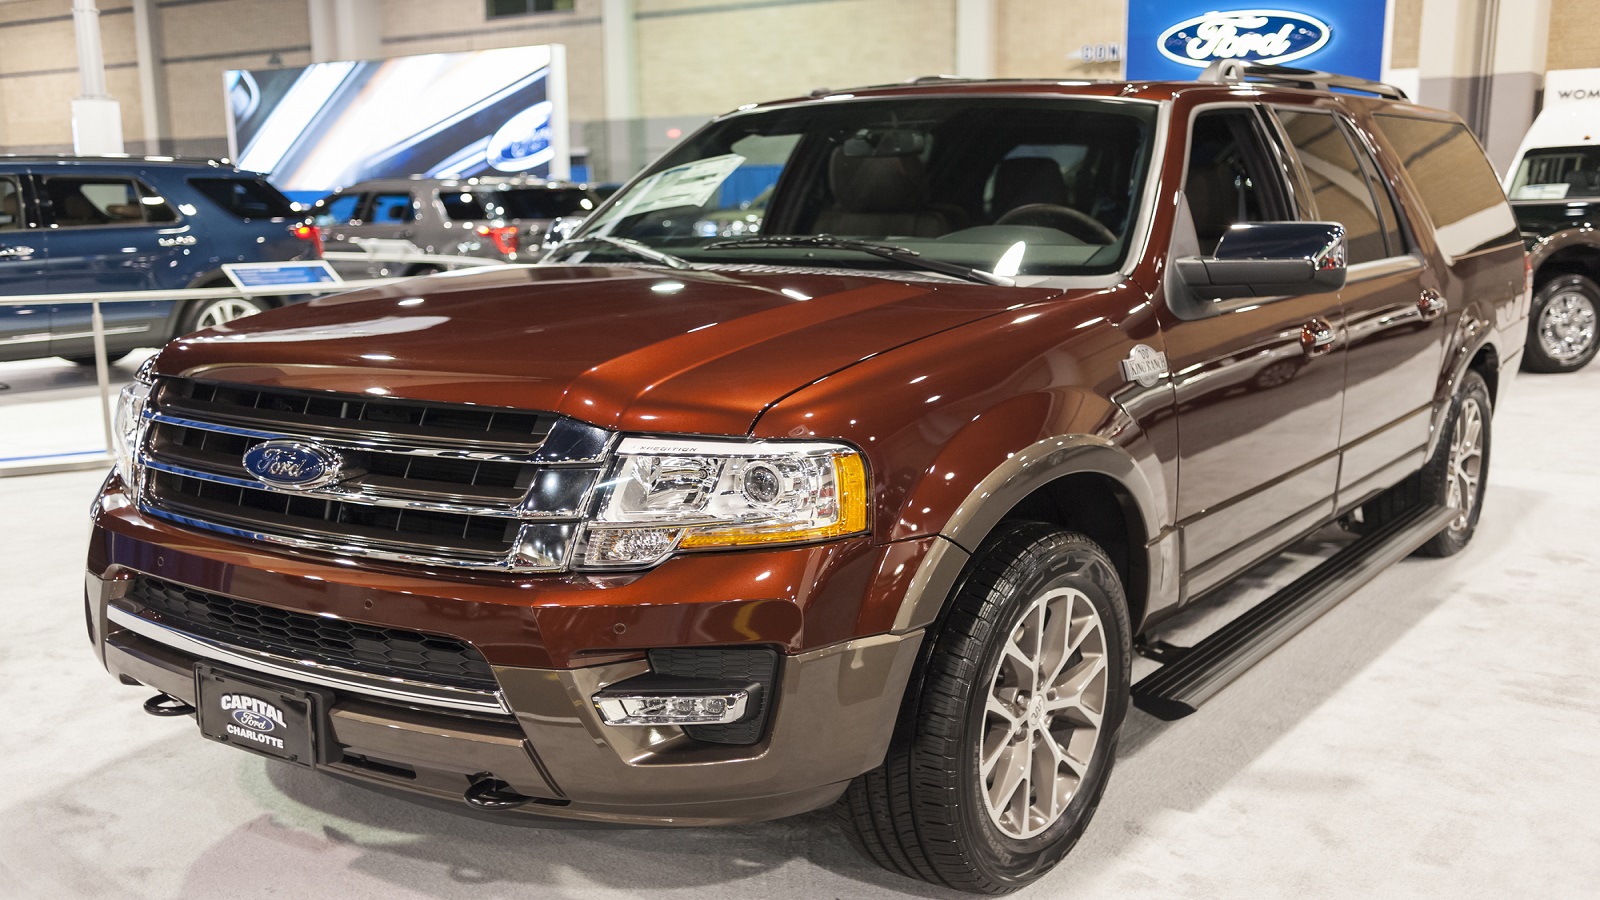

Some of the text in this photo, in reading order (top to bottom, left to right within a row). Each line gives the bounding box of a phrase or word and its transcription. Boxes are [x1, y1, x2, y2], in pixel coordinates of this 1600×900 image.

[1186, 11, 1295, 59] Ford
[257, 448, 307, 477] Ford
[221, 695, 287, 728] CAPITAL
[241, 711, 266, 730] Ford
[226, 724, 284, 749] CHARLOTTE
